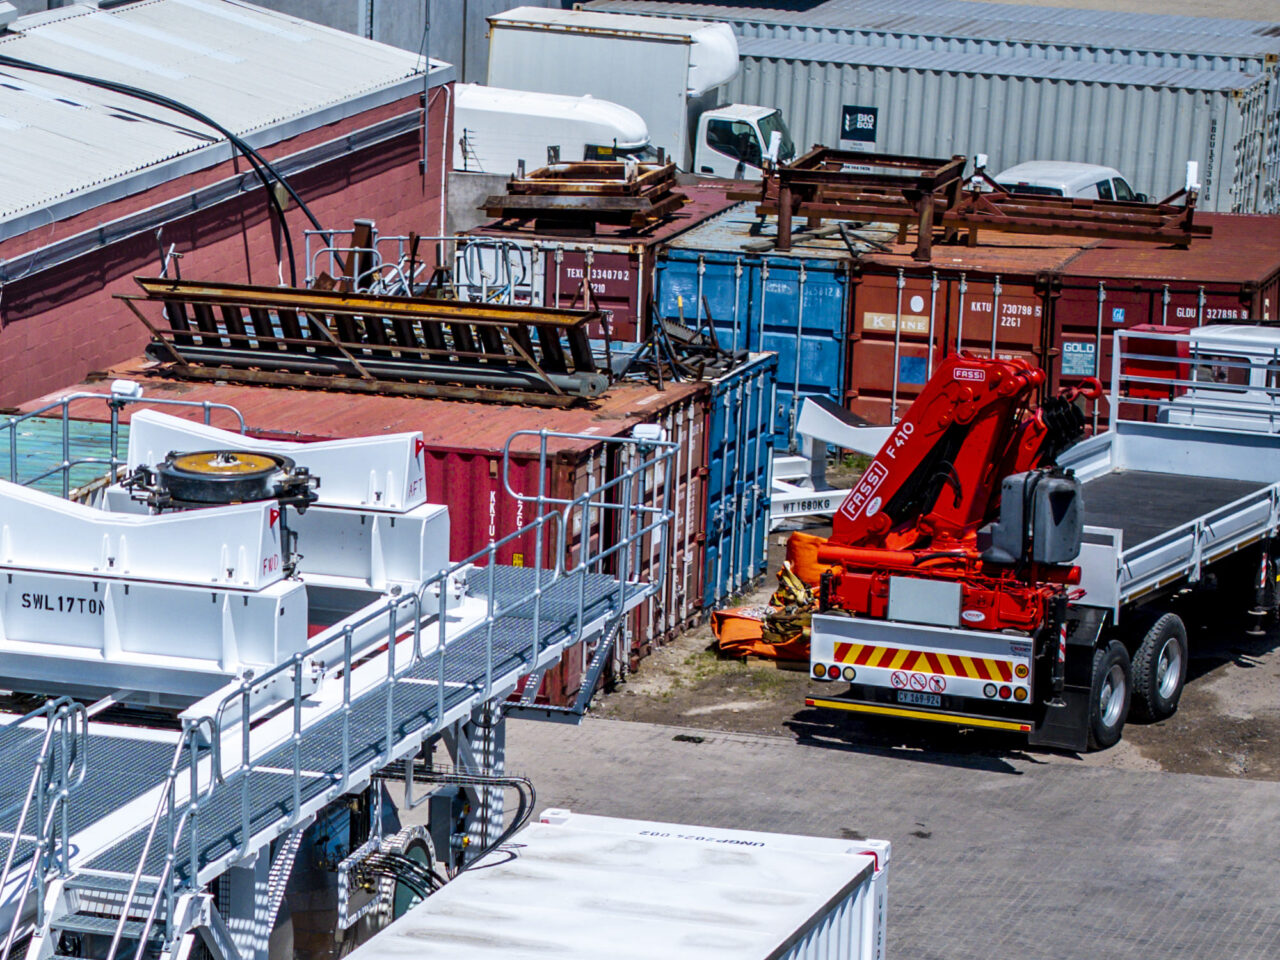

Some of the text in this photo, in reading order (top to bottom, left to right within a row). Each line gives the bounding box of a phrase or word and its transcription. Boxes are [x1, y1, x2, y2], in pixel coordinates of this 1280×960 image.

[857, 113, 875, 123] BIG
[856, 121, 874, 129] BOX
[970, 301, 992, 313] KKTU
[1002, 304, 1032, 316] 730798
[1176, 307, 1196, 318] GLDU
[872, 315, 886, 329] K
[1001, 317, 1021, 328] 22G1
[1063, 342, 1095, 353] GOLD
[956, 370, 983, 379] FASSI
[894, 422, 914, 447] 410
[846, 466, 884, 514] FASSI
[263, 554, 279, 576] FWD
